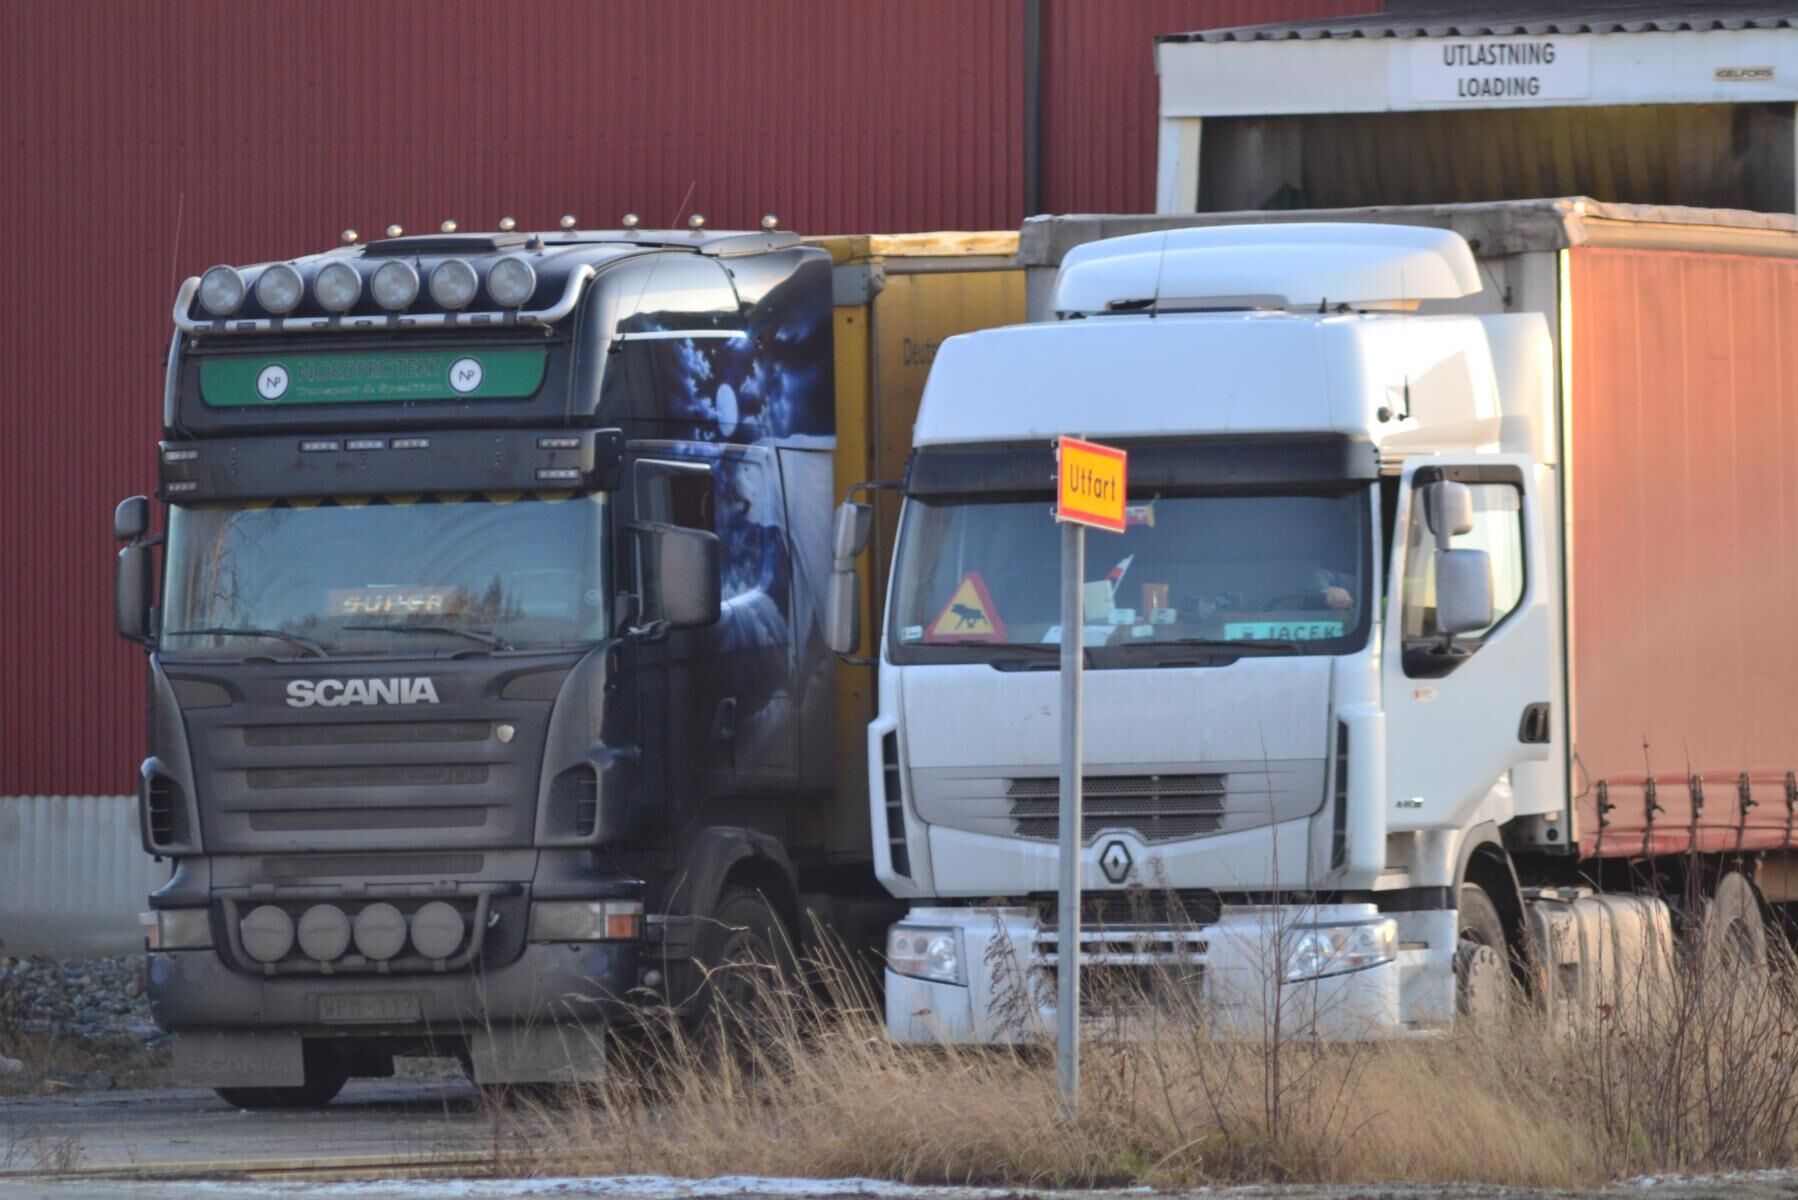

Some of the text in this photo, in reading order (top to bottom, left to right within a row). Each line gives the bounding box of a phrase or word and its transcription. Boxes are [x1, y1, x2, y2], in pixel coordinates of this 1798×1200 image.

[1443, 42, 1556, 66] UTLASTNING
[1457, 76, 1541, 97] LOADING
[1069, 464, 1116, 502] Utfart
[285, 677, 440, 708] SCANIA
